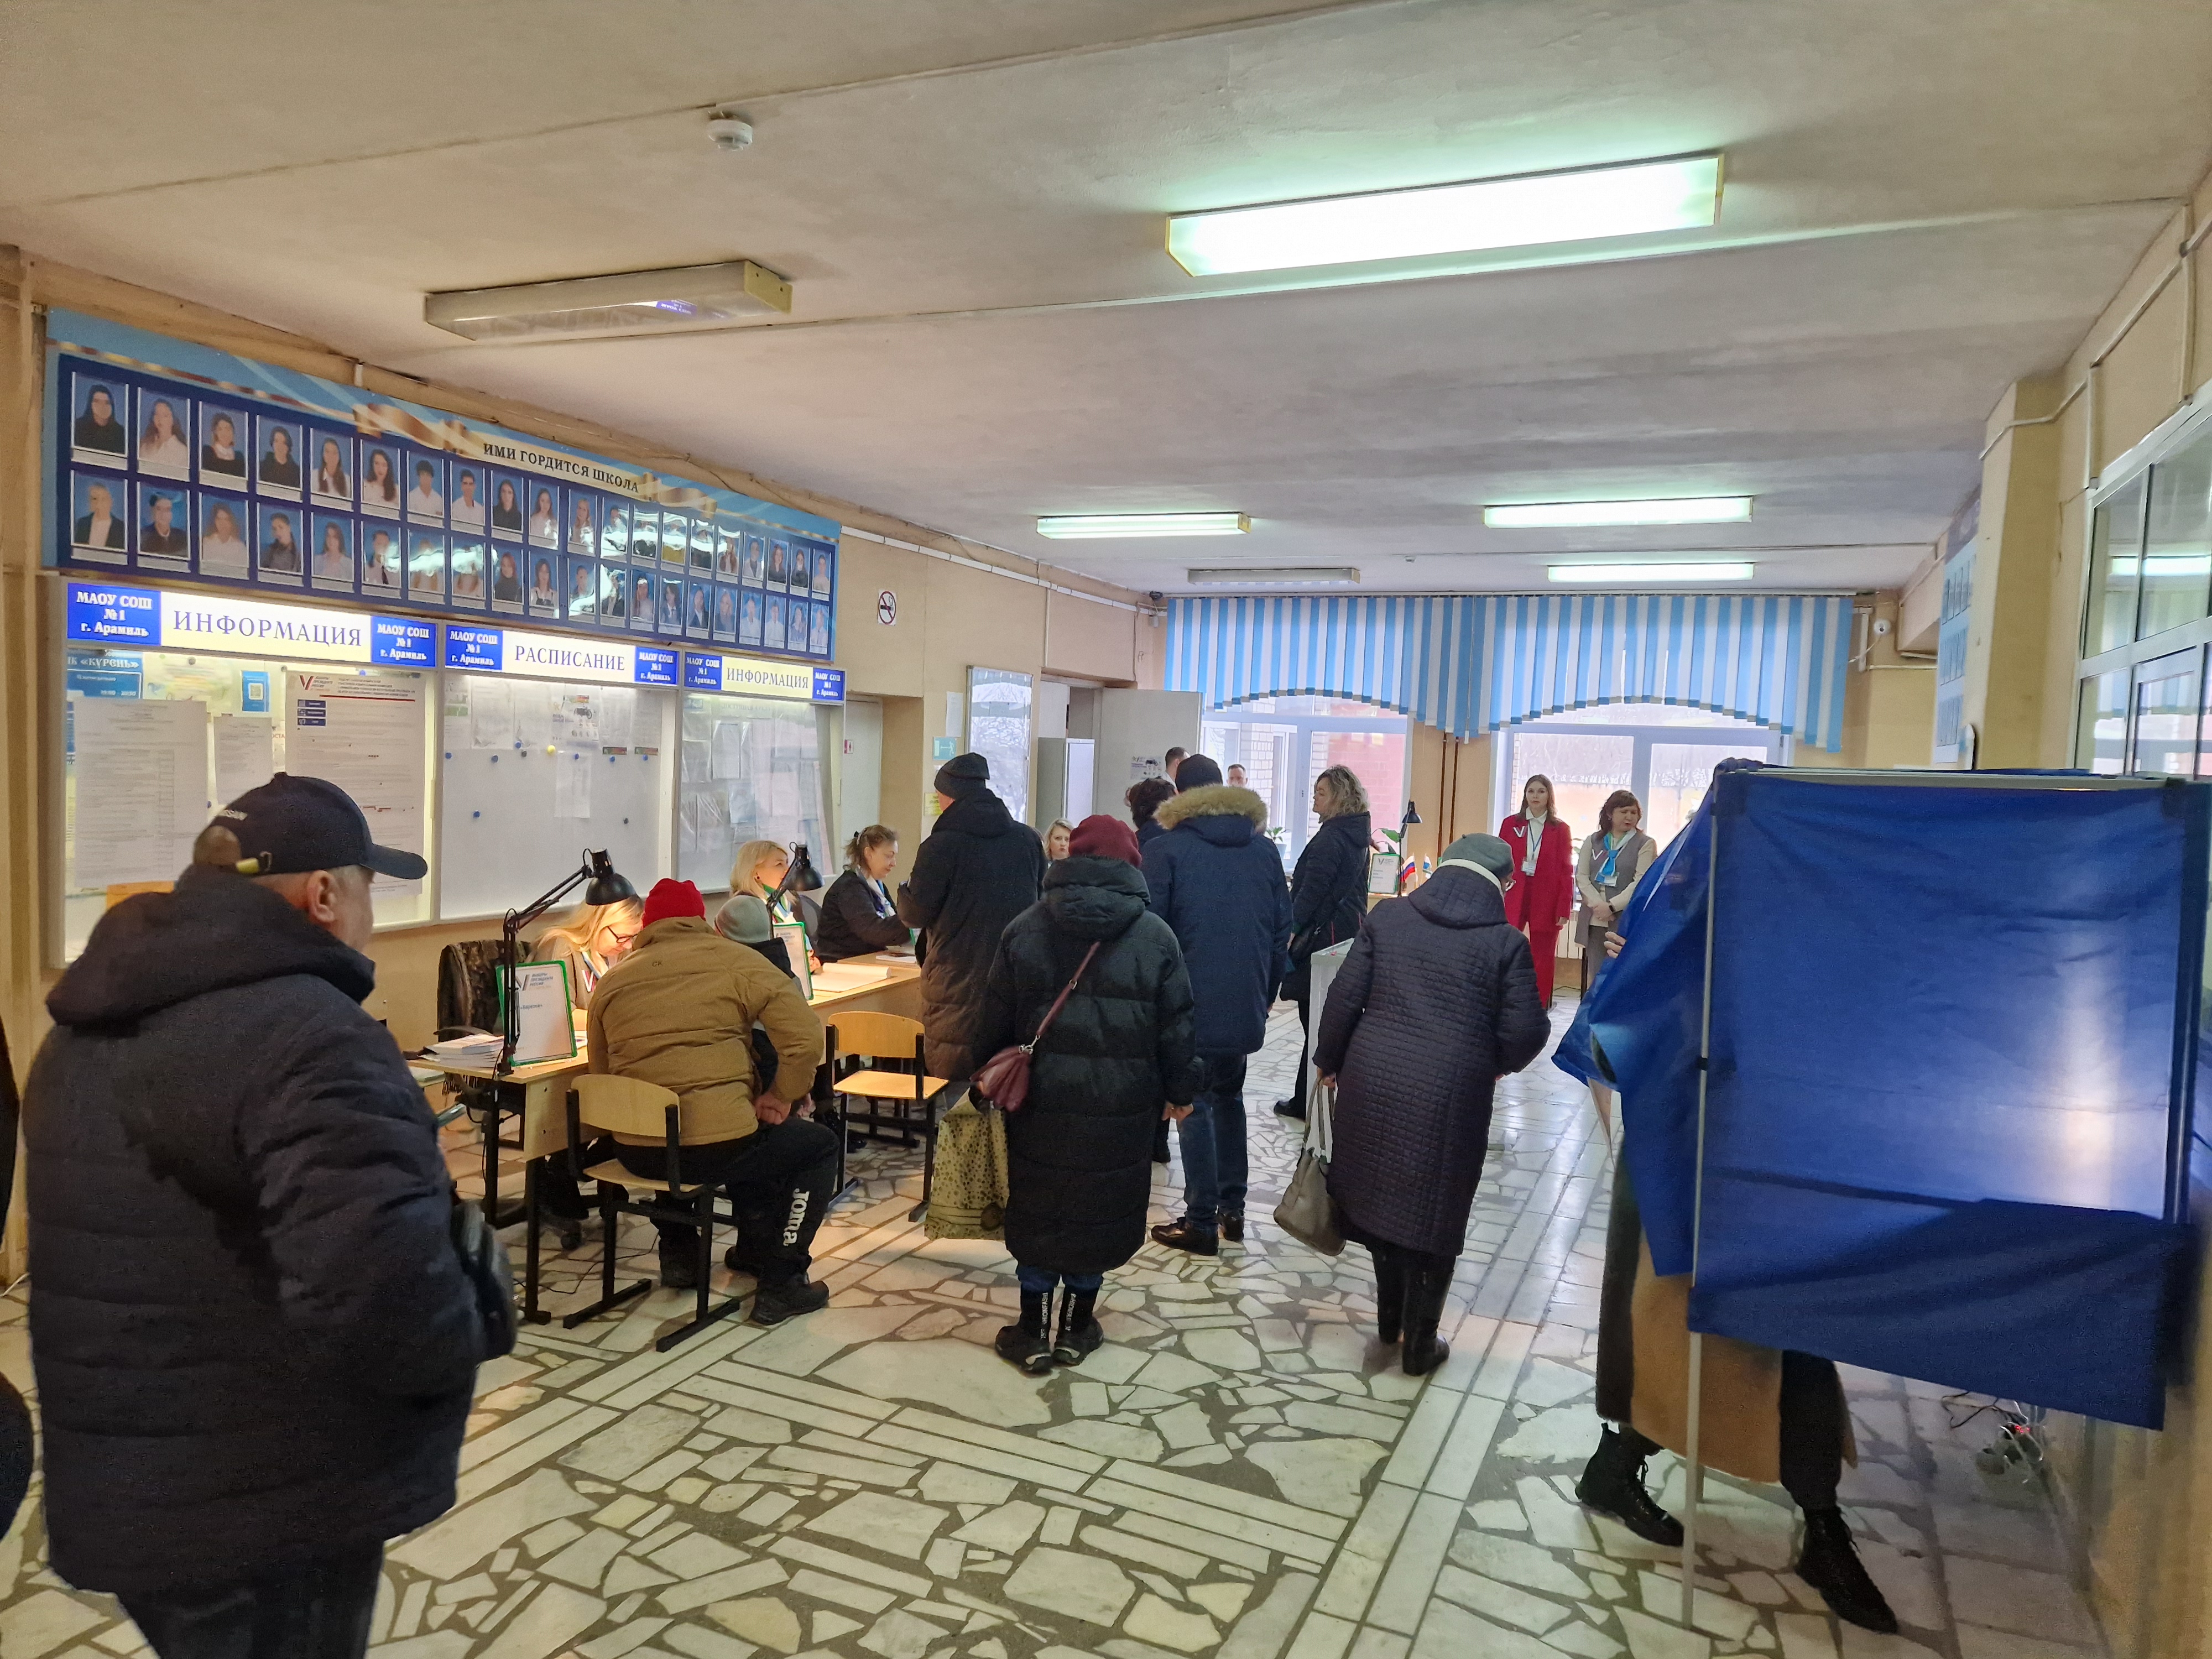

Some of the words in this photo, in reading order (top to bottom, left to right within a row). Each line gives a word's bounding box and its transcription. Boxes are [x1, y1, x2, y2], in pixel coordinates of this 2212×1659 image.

[483, 443, 516, 460] ИМИ
[520, 451, 589, 477] ГОРДИТСЯ
[592, 468, 639, 493] ШКОЛА
[76, 591, 117, 606] МАОУ
[120, 596, 152, 610] СОШ
[81, 623, 91, 632] г.
[94, 622, 149, 637] Арамиль
[174, 611, 361, 646] ИНФОРМАЦИЯ
[377, 624, 406, 637] МАОУ
[407, 627, 430, 639] СОШ
[450, 630, 476, 642] МАОУ
[477, 633, 498, 645] СОШ
[390, 649, 426, 661] Арамиль
[460, 654, 494, 666] Арамиль
[515, 645, 625, 671] РАСПИСАНИЕ
[639, 652, 658, 662] МАОУ
[658, 654, 674, 664] СОШ
[686, 657, 703, 665] МАОУ
[705, 659, 720, 668] СОШ
[646, 671, 671, 681] Арамиль
[693, 676, 717, 685] Арамиль
[727, 667, 808, 689] ИНФОРМАЦИЯ
[783, 1188, 810, 1247] Joma
